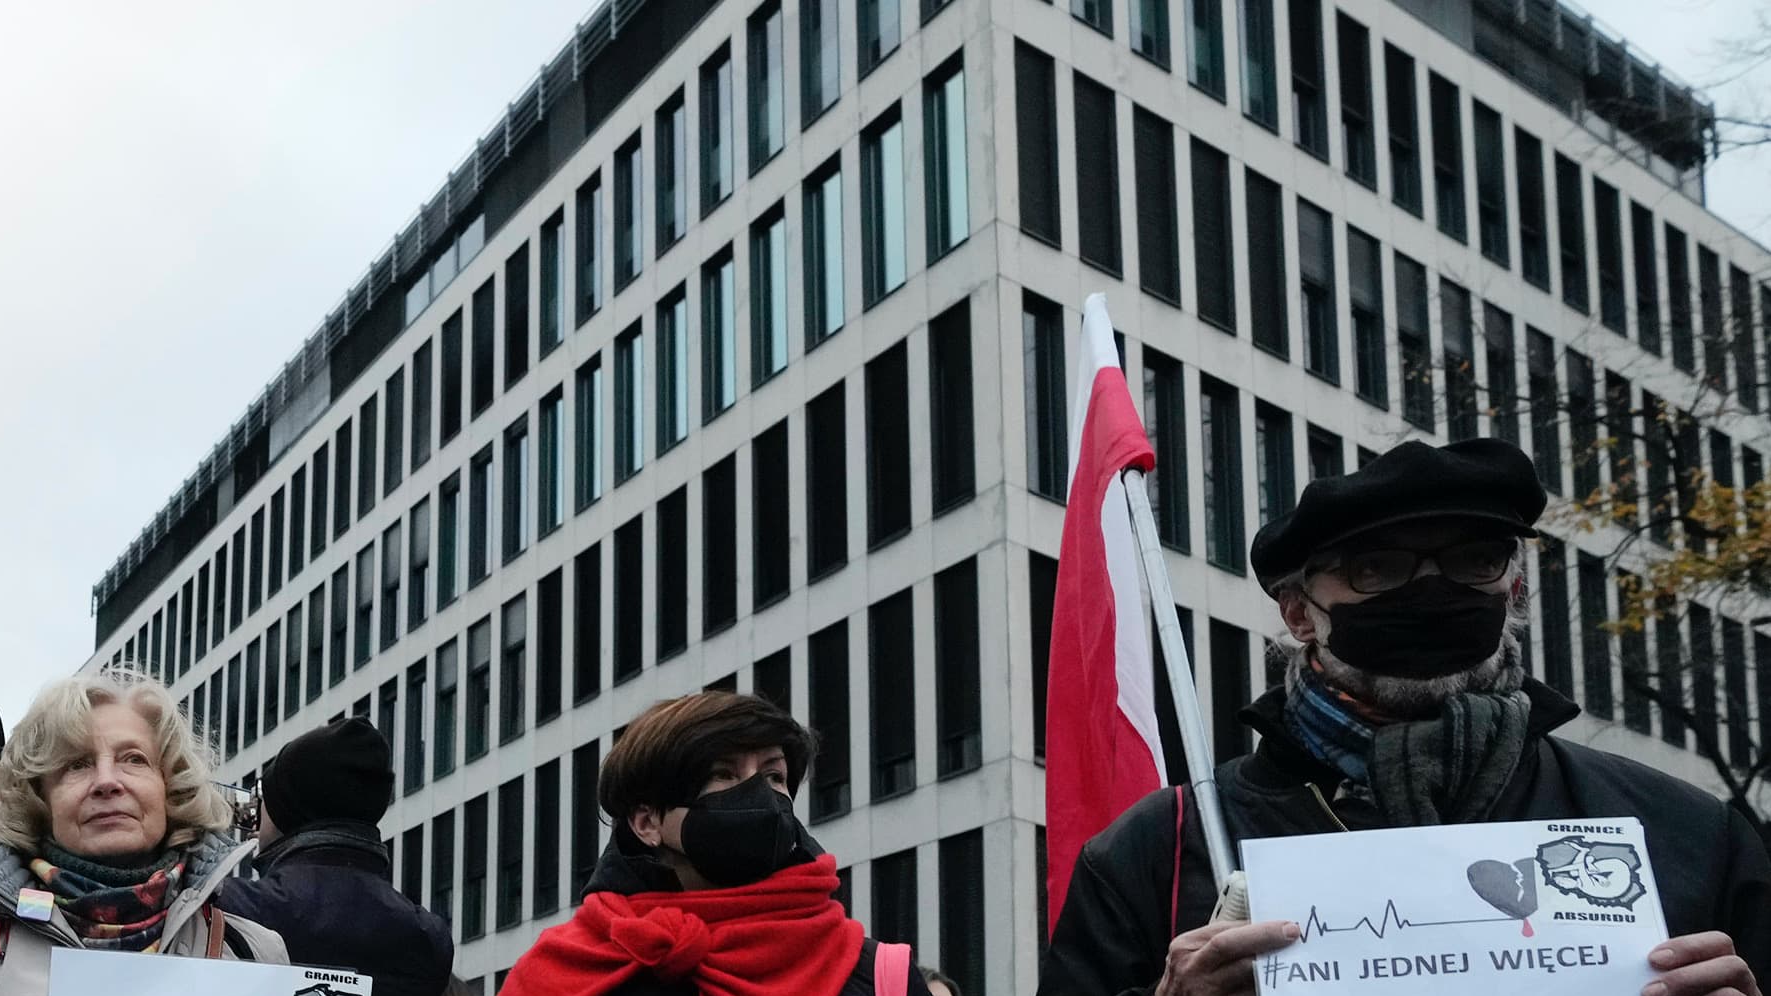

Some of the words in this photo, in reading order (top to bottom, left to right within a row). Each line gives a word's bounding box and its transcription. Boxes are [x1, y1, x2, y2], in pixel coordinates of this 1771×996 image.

[1546, 822, 1626, 836] GRANICE
[1552, 910, 1637, 924] ABSURDU
[1358, 951, 1469, 980] JEDNEJ
[1489, 944, 1611, 974] WIĘCEJ
[304, 969, 360, 986] GRANICE
